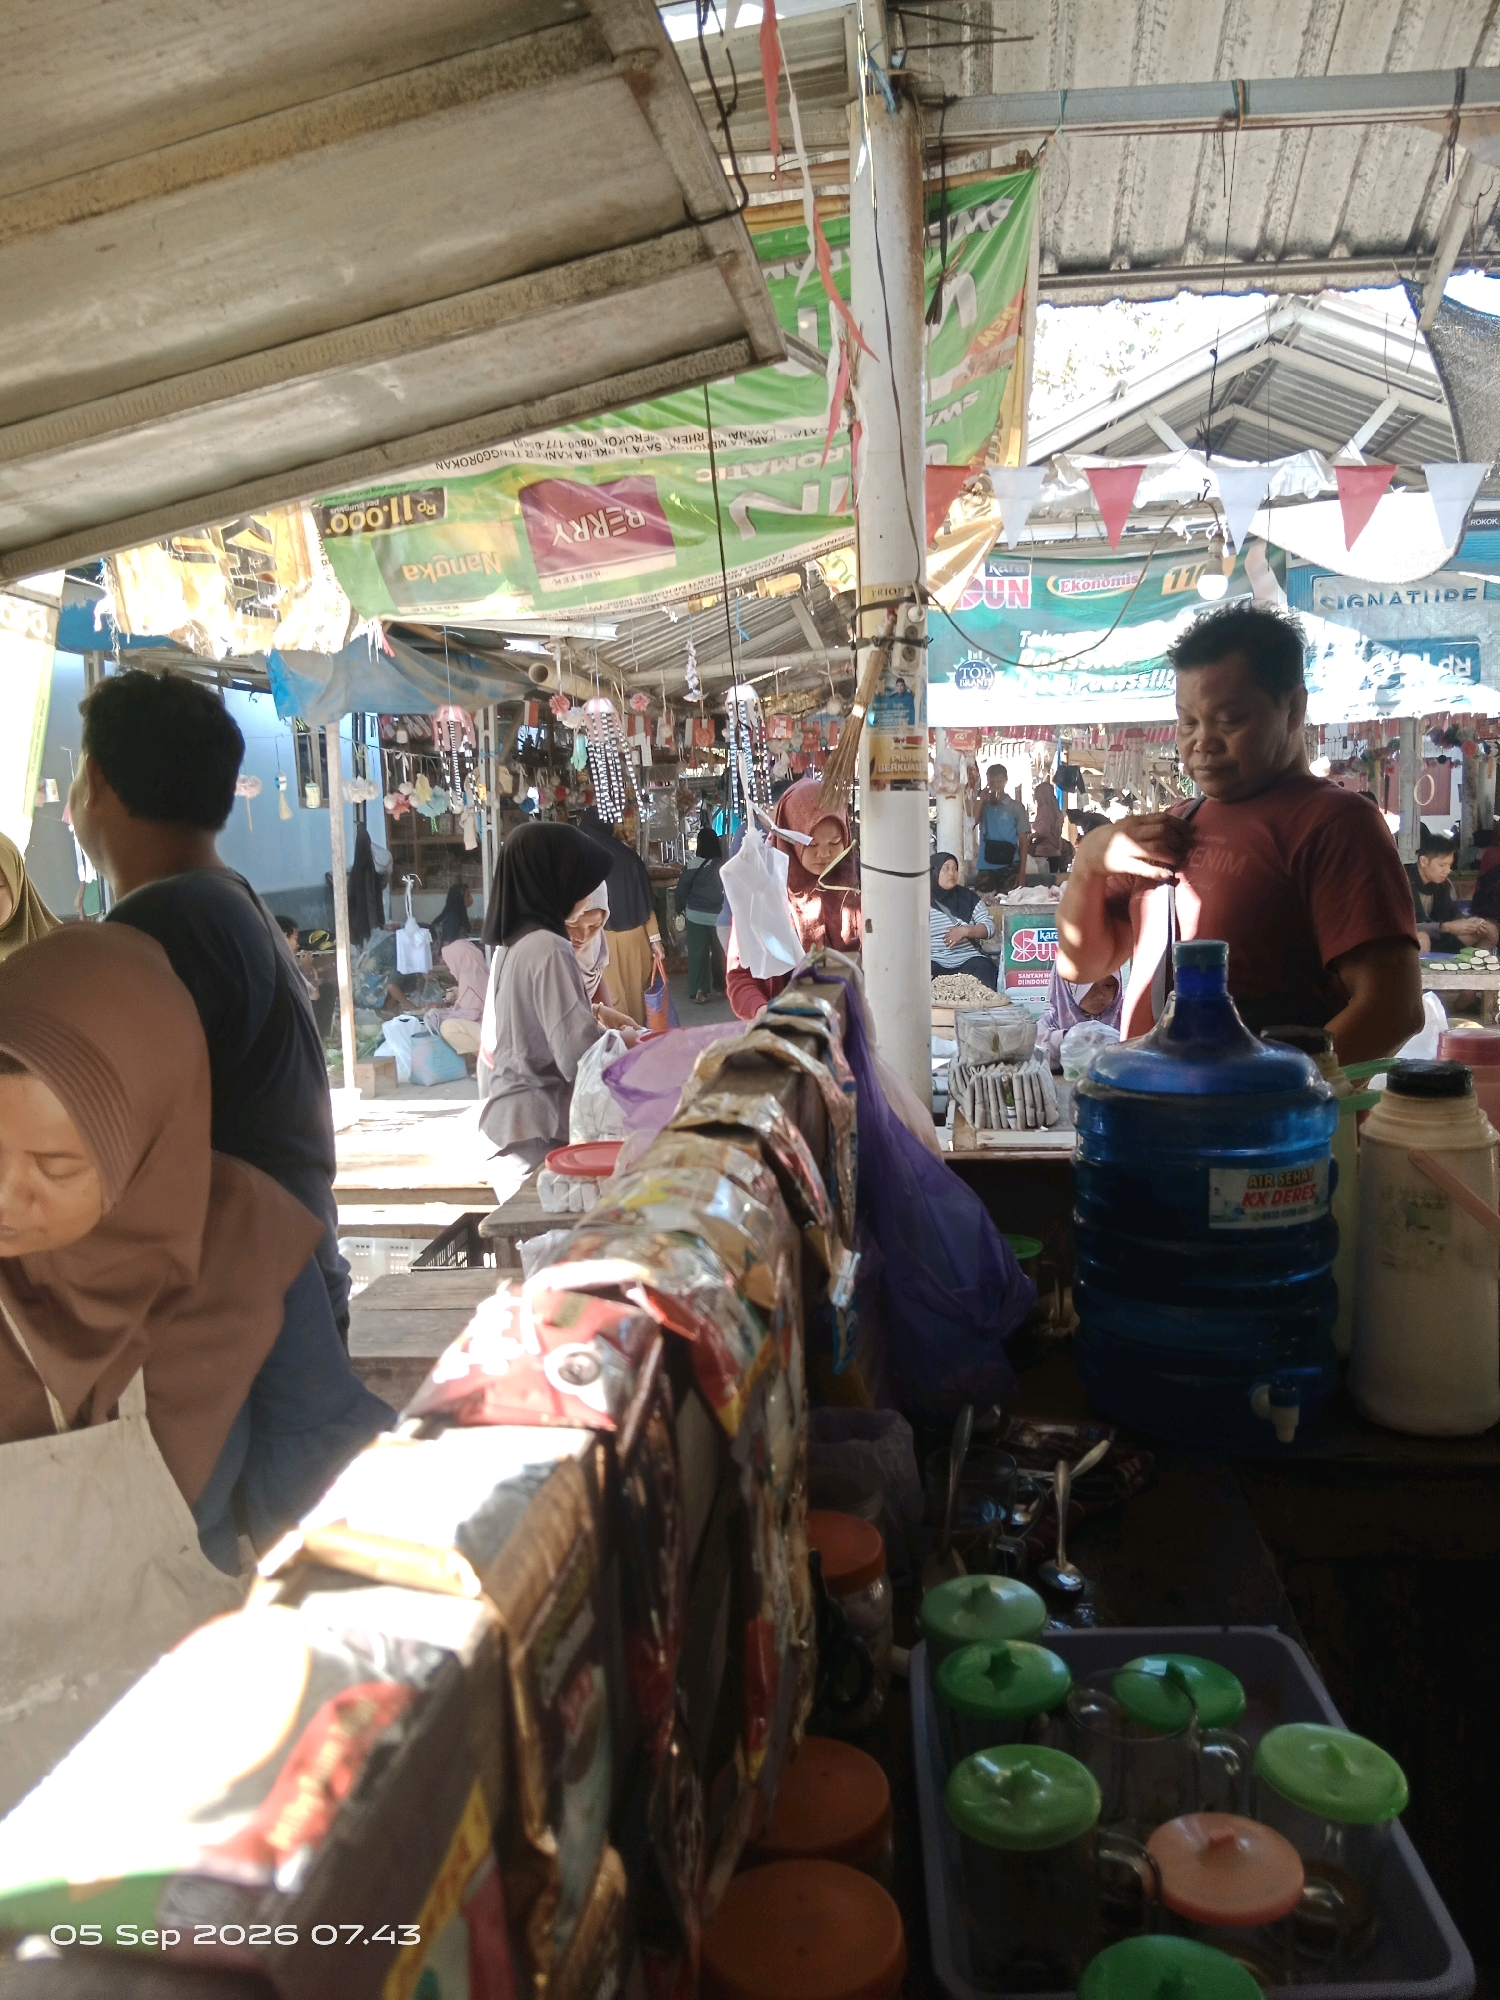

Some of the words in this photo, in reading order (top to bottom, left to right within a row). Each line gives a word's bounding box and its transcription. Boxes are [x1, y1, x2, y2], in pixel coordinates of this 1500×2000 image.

[977, 306, 1017, 347] NEW
[435, 449, 521, 470] TENGGOROKAN
[633, 443, 662, 454] SAYA
[695, 443, 852, 483] ROMATIC
[329, 501, 365, 515] bungkus
[366, 499, 379, 508] per
[417, 499, 437, 516] Rp
[552, 506, 646, 547] BERRY
[402, 551, 502, 584] Nangka
[552, 570, 601, 586] KRETEK
[1059, 572, 1141, 595] Ekonomis
[959, 667, 991, 679] TOP
[1437, 653, 1472, 676] Rp
[1188, 847, 1248, 876] ENIM
[1247, 1174, 1275, 1190] AIR
[1278, 1167, 1315, 1187] SEHAT
[1241, 1191, 1270, 1209] KX
[1271, 1183, 1318, 1206] DERES
